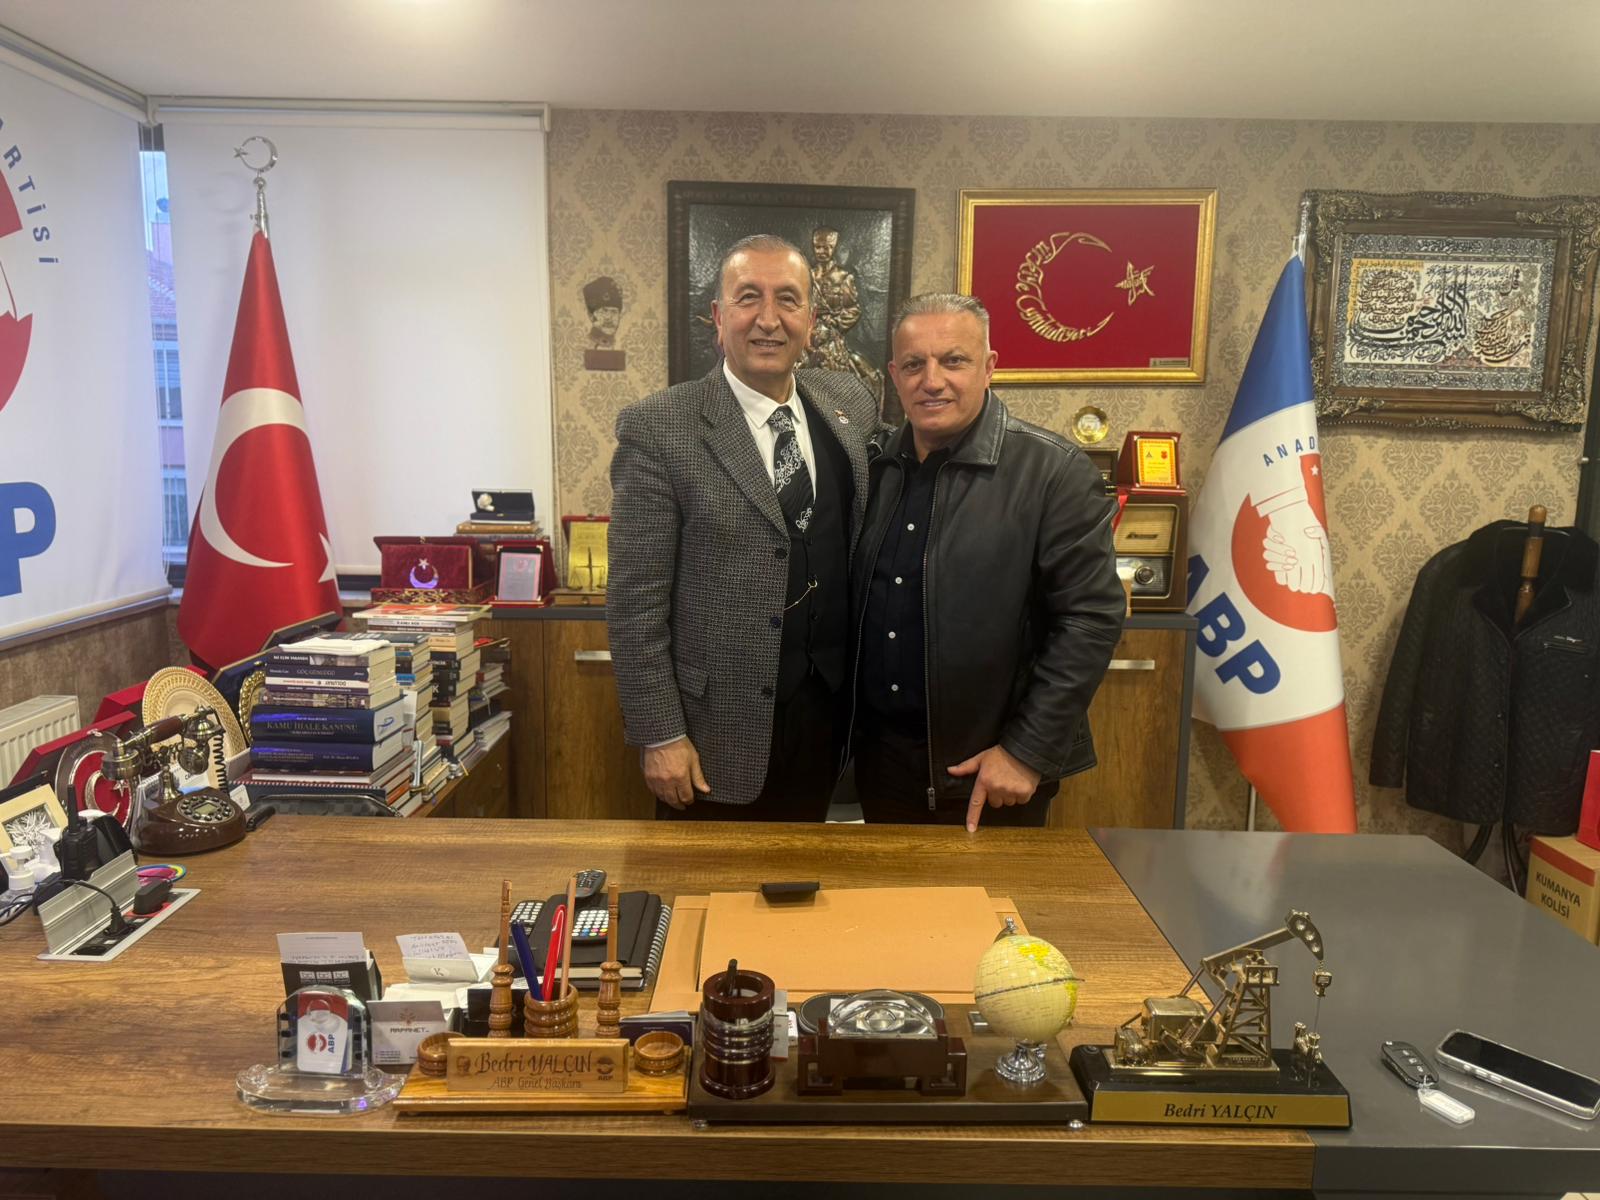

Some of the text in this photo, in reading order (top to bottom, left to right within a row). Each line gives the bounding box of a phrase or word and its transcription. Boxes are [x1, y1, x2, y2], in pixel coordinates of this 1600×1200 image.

[0, 117, 59, 264] RTİSİ
[1536, 871, 1581, 908] KUMANYA
[1541, 892, 1570, 919] KOLİSİ
[327, 1033, 336, 1054] ABP
[475, 1051, 591, 1077] Bedri YALÇIN
[1164, 1103, 1278, 1122] Bedri YALÇIN
